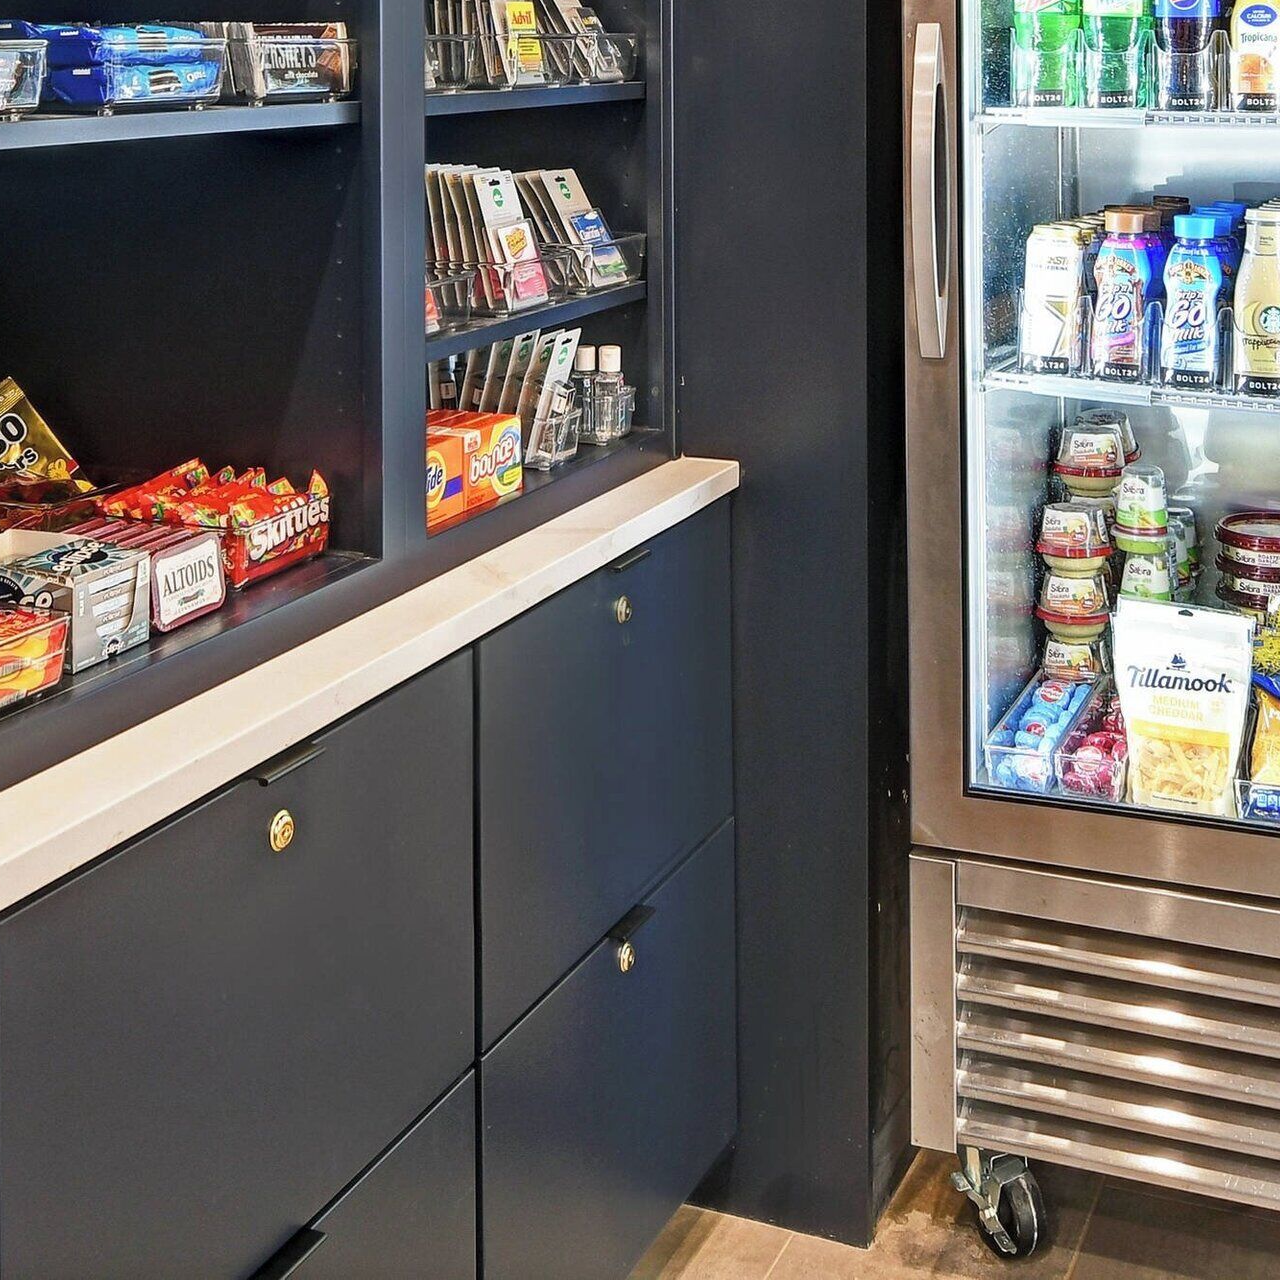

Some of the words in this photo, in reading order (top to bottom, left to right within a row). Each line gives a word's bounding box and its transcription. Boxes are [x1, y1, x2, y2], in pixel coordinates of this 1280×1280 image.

[511, 9, 533, 26] Advil
[1241, 32, 1278, 44] Tropicana
[1100, 95, 1134, 104] BOLT24
[1172, 98, 1205, 106] BOLT24
[1105, 367, 1138, 378] BOLT24
[1176, 373, 1210, 384] BOLT24
[1073, 439, 1094, 450] Sabra
[471, 434, 515, 484] bounce
[1044, 516, 1061, 528] Sabra
[248, 495, 330, 562] Skittles
[1235, 552, 1256, 564] Sabra
[163, 554, 215, 598] ALTOIDS
[1128, 563, 1152, 577] Sabra
[1050, 583, 1069, 595] Sabra
[1239, 581, 1261, 594] Sabra
[1127, 663, 1232, 694] Tillamook
